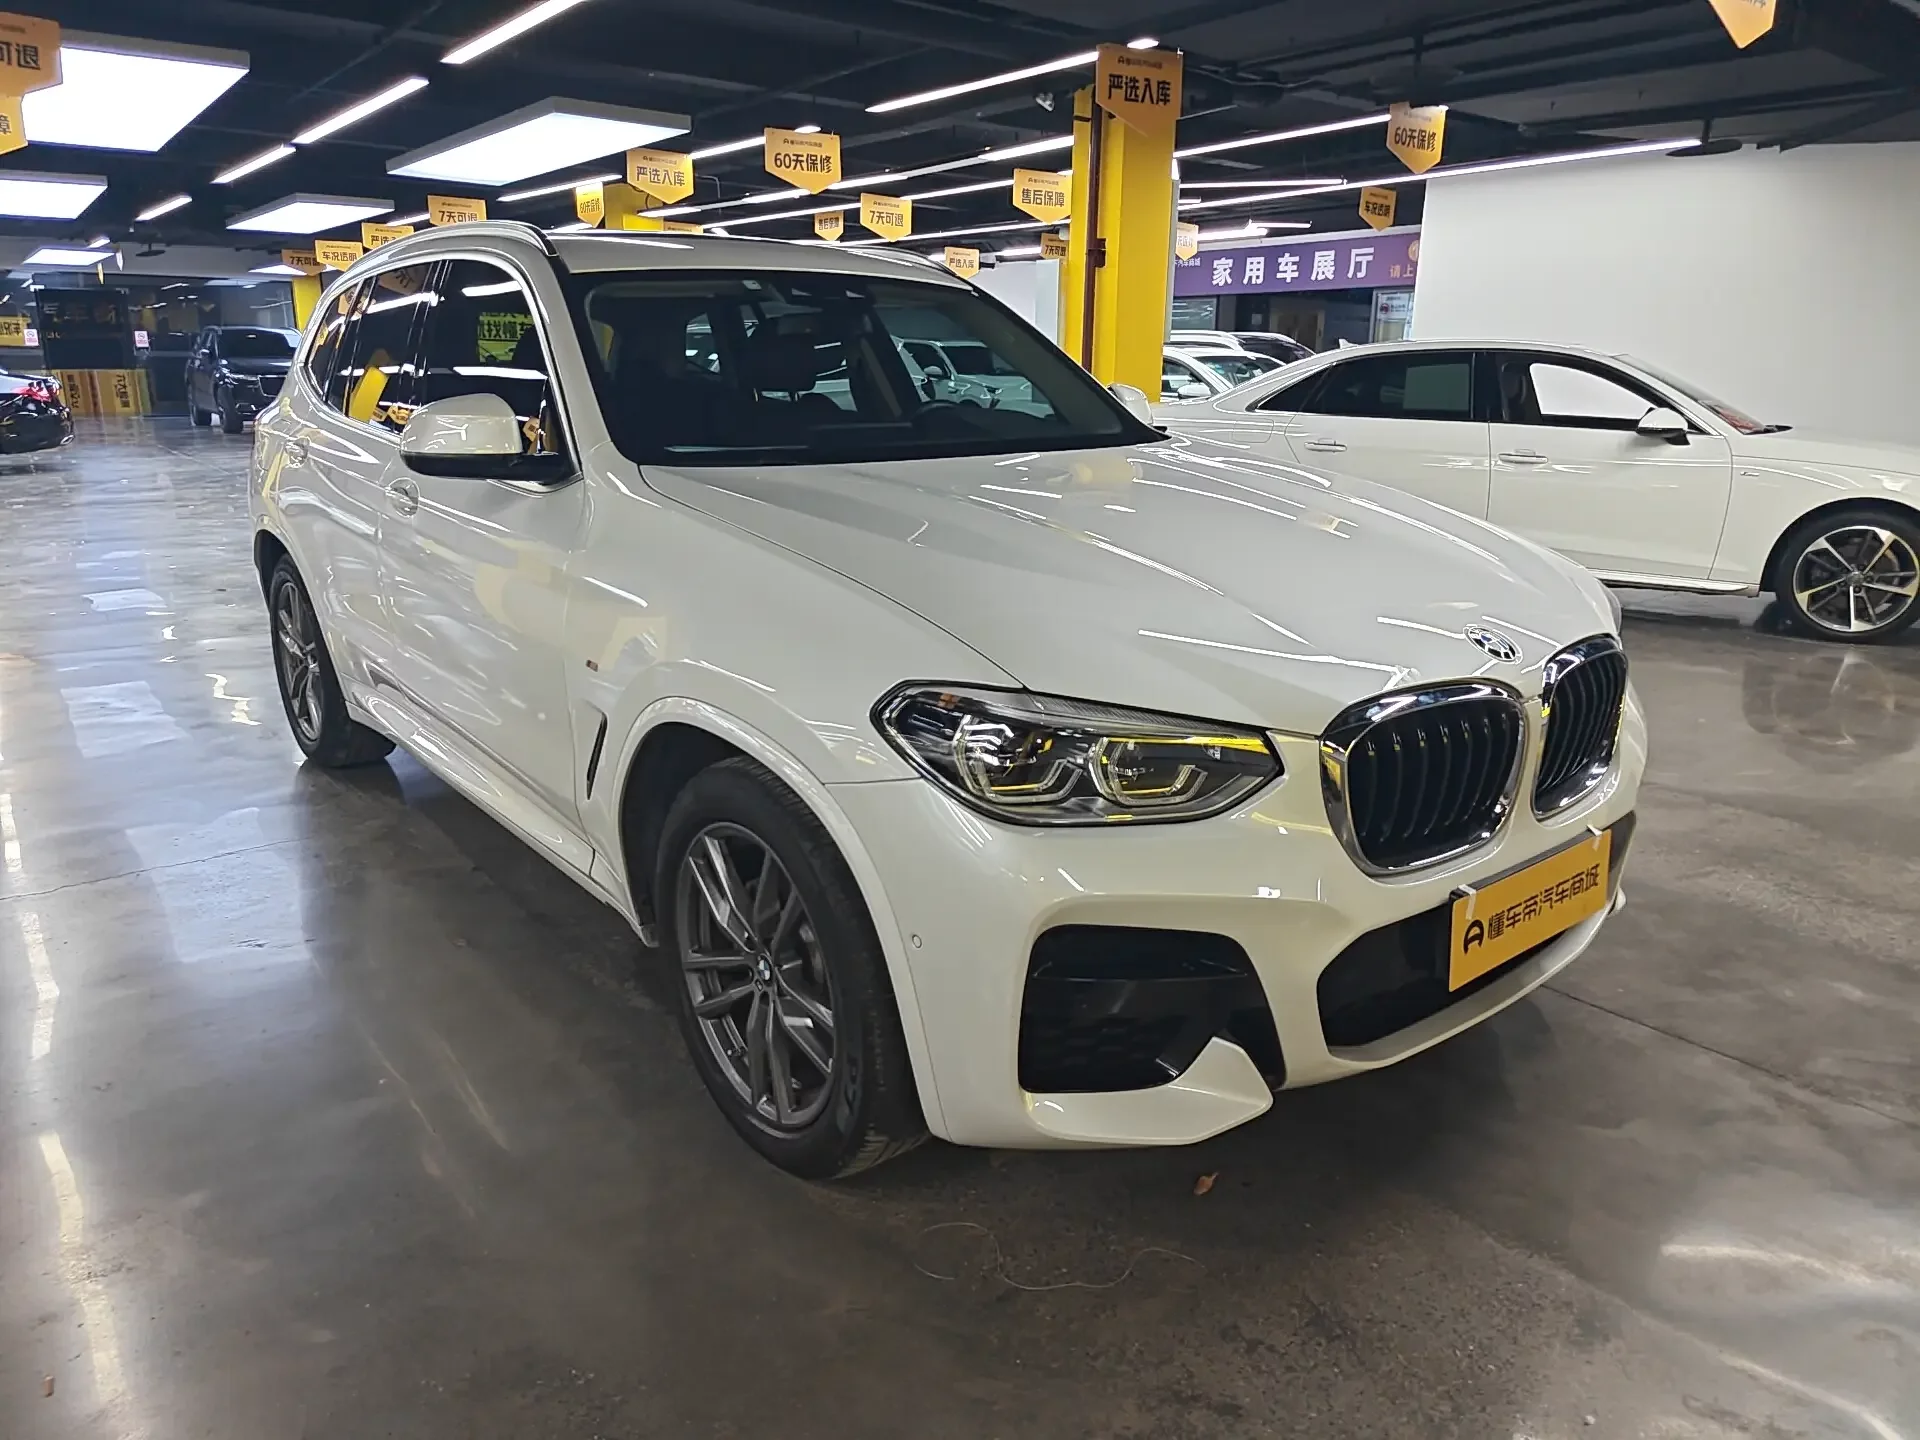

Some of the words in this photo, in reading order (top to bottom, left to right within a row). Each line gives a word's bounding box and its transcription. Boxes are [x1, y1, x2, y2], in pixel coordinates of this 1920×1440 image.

[1108, 73, 1172, 106] 严选入库
[1394, 127, 1437, 152] 60天保修
[774, 152, 833, 174] 60天保修
[636, 165, 686, 187] 严选入库
[1021, 187, 1065, 207] 售后保障
[438, 210, 478, 223] 7天可退
[869, 210, 904, 227] 7天可退
[1363, 201, 1391, 218] 车况透明
[321, 251, 358, 262] 车况透明
[1044, 244, 1067, 257] 7天可退
[949, 257, 975, 269] 严选入库
[1211, 246, 1375, 287] 家用车展厅
[1487, 863, 1601, 940] 懂车帝汽车商城
